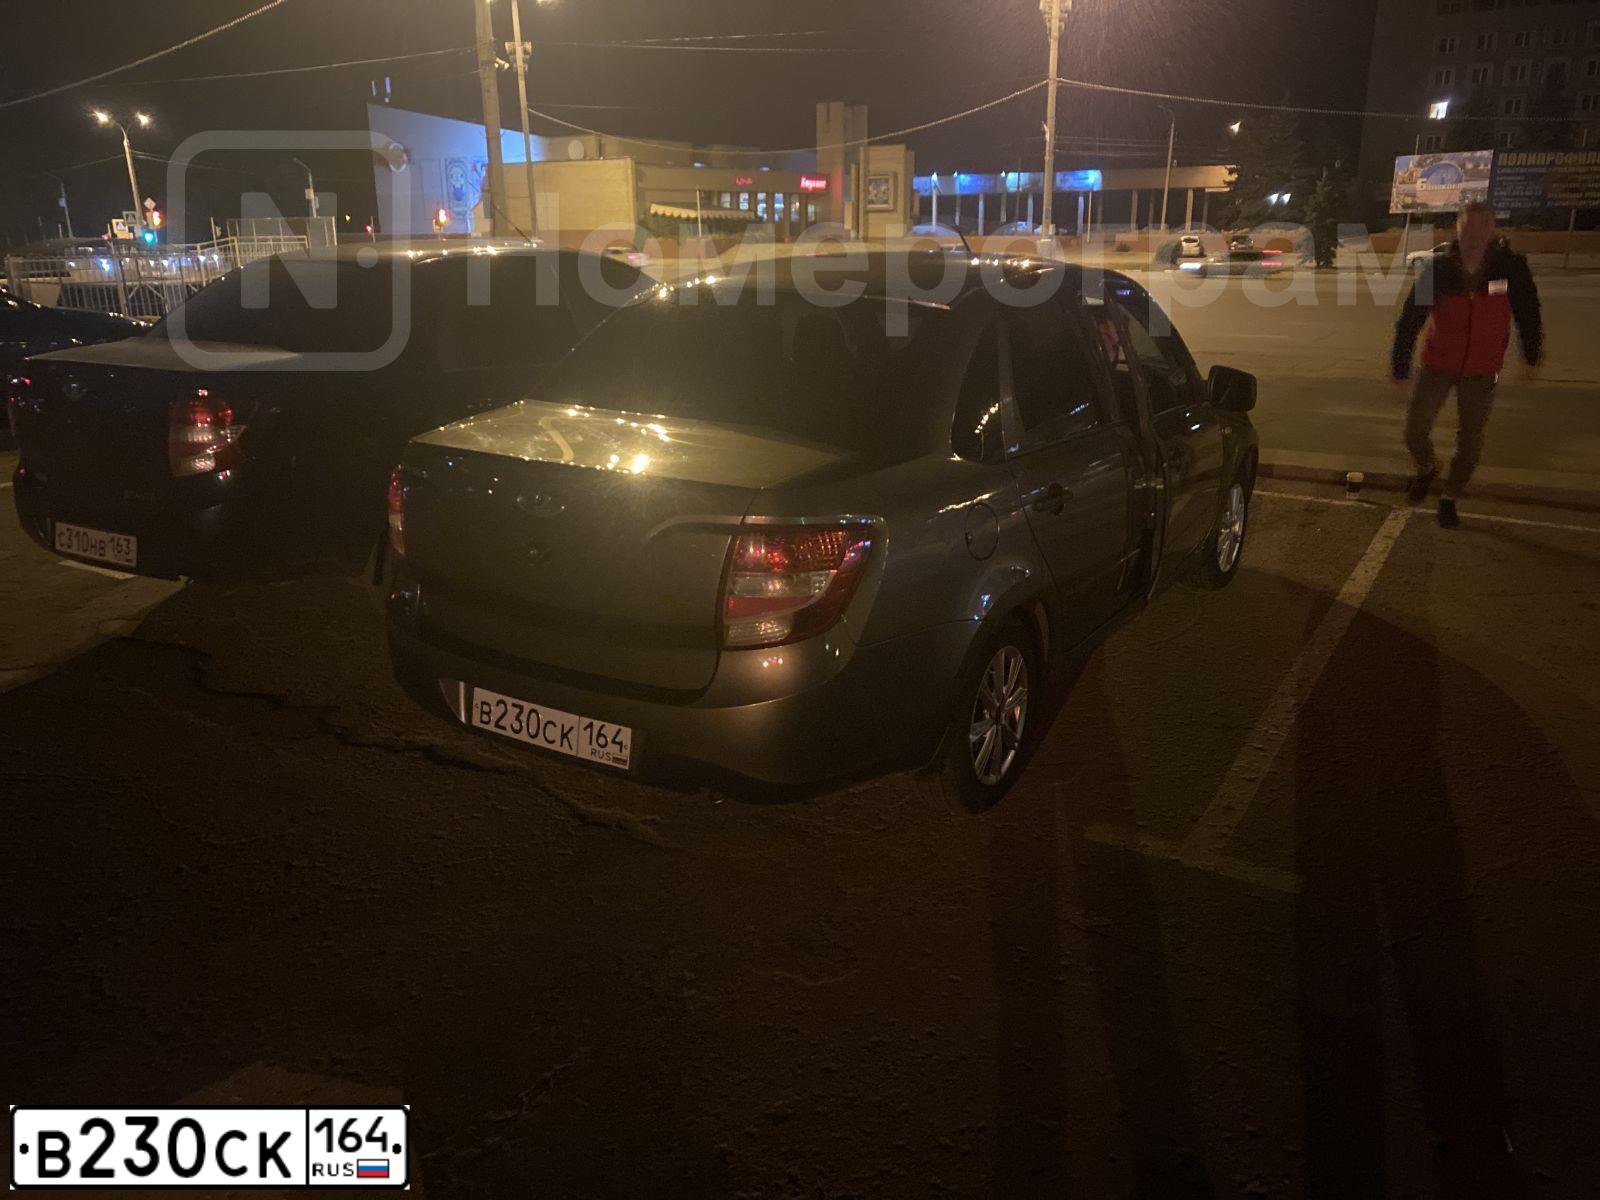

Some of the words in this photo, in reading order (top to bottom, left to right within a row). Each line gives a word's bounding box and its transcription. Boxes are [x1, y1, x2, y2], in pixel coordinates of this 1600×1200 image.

[108, 536, 132, 555] 163
[479, 698, 575, 750] В230СК
[583, 721, 625, 753] 164
[590, 748, 612, 762] RUS
